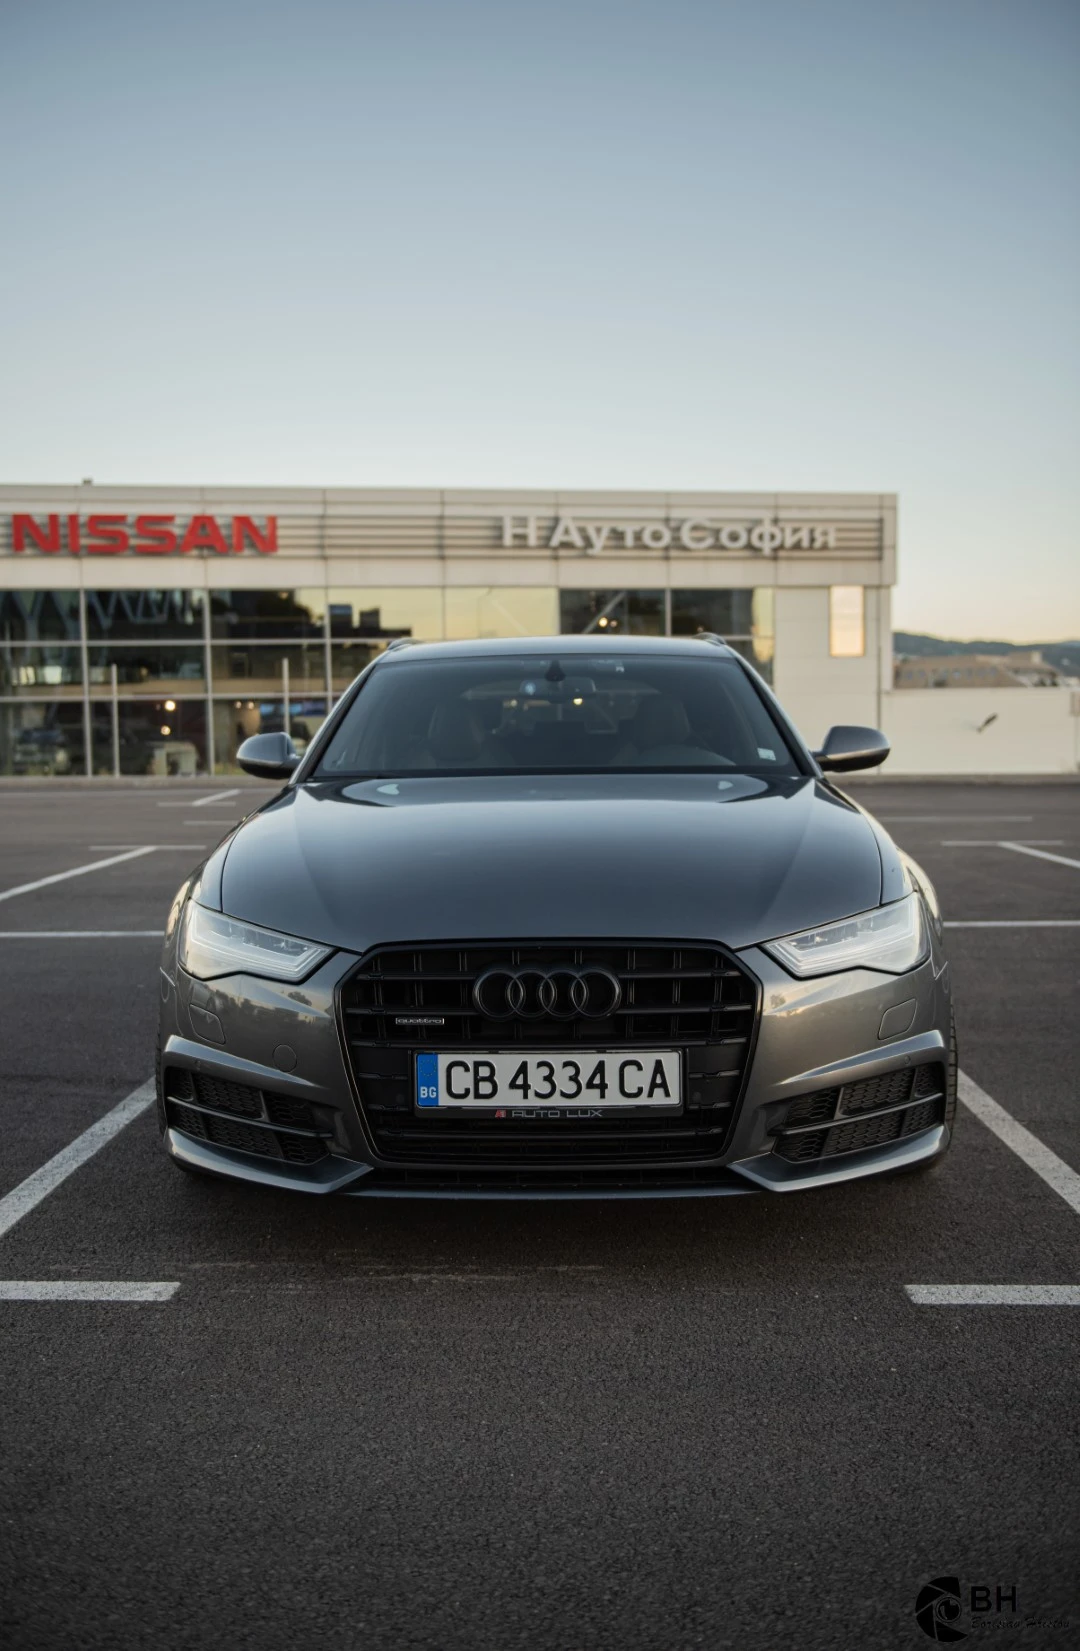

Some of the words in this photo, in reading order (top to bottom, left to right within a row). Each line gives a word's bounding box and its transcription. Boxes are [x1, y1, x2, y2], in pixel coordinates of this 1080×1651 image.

[11, 513, 279, 554] NISSAN
[501, 514, 537, 547] Н
[548, 516, 672, 555] Ауто
[681, 517, 837, 555] София
[420, 1086, 437, 1098] BG
[445, 1060, 499, 1100] CB
[508, 1060, 609, 1100] 4334
[619, 1059, 671, 1099] CA
[512, 1110, 560, 1118] AUTO
[566, 1110, 603, 1118] LUX
